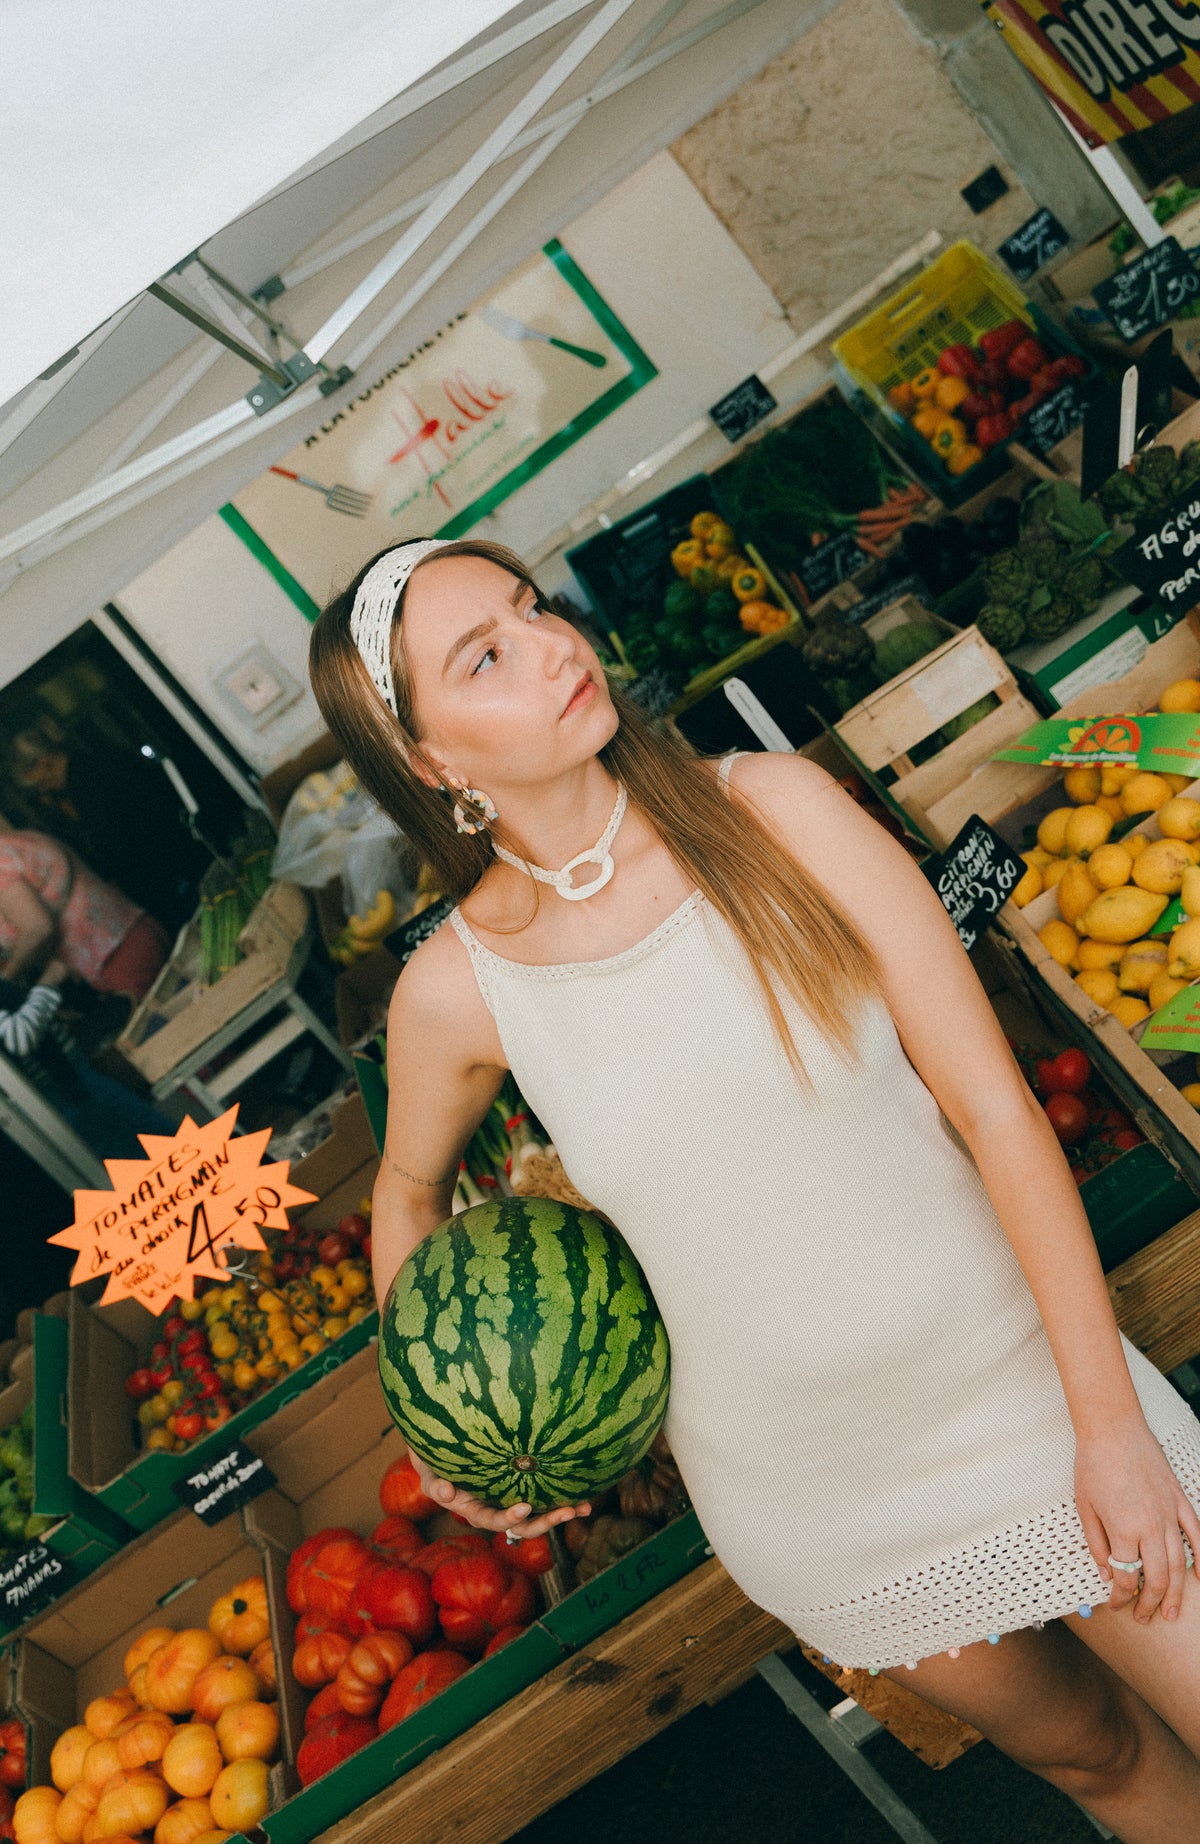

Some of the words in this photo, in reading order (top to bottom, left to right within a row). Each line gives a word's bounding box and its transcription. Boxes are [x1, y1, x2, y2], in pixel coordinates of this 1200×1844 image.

[388, 367, 516, 508] Halle
[938, 826, 986, 893] CITRONS
[84, 1144, 201, 1236] TOMATES
[6, 1558, 62, 1607] ANANAS
